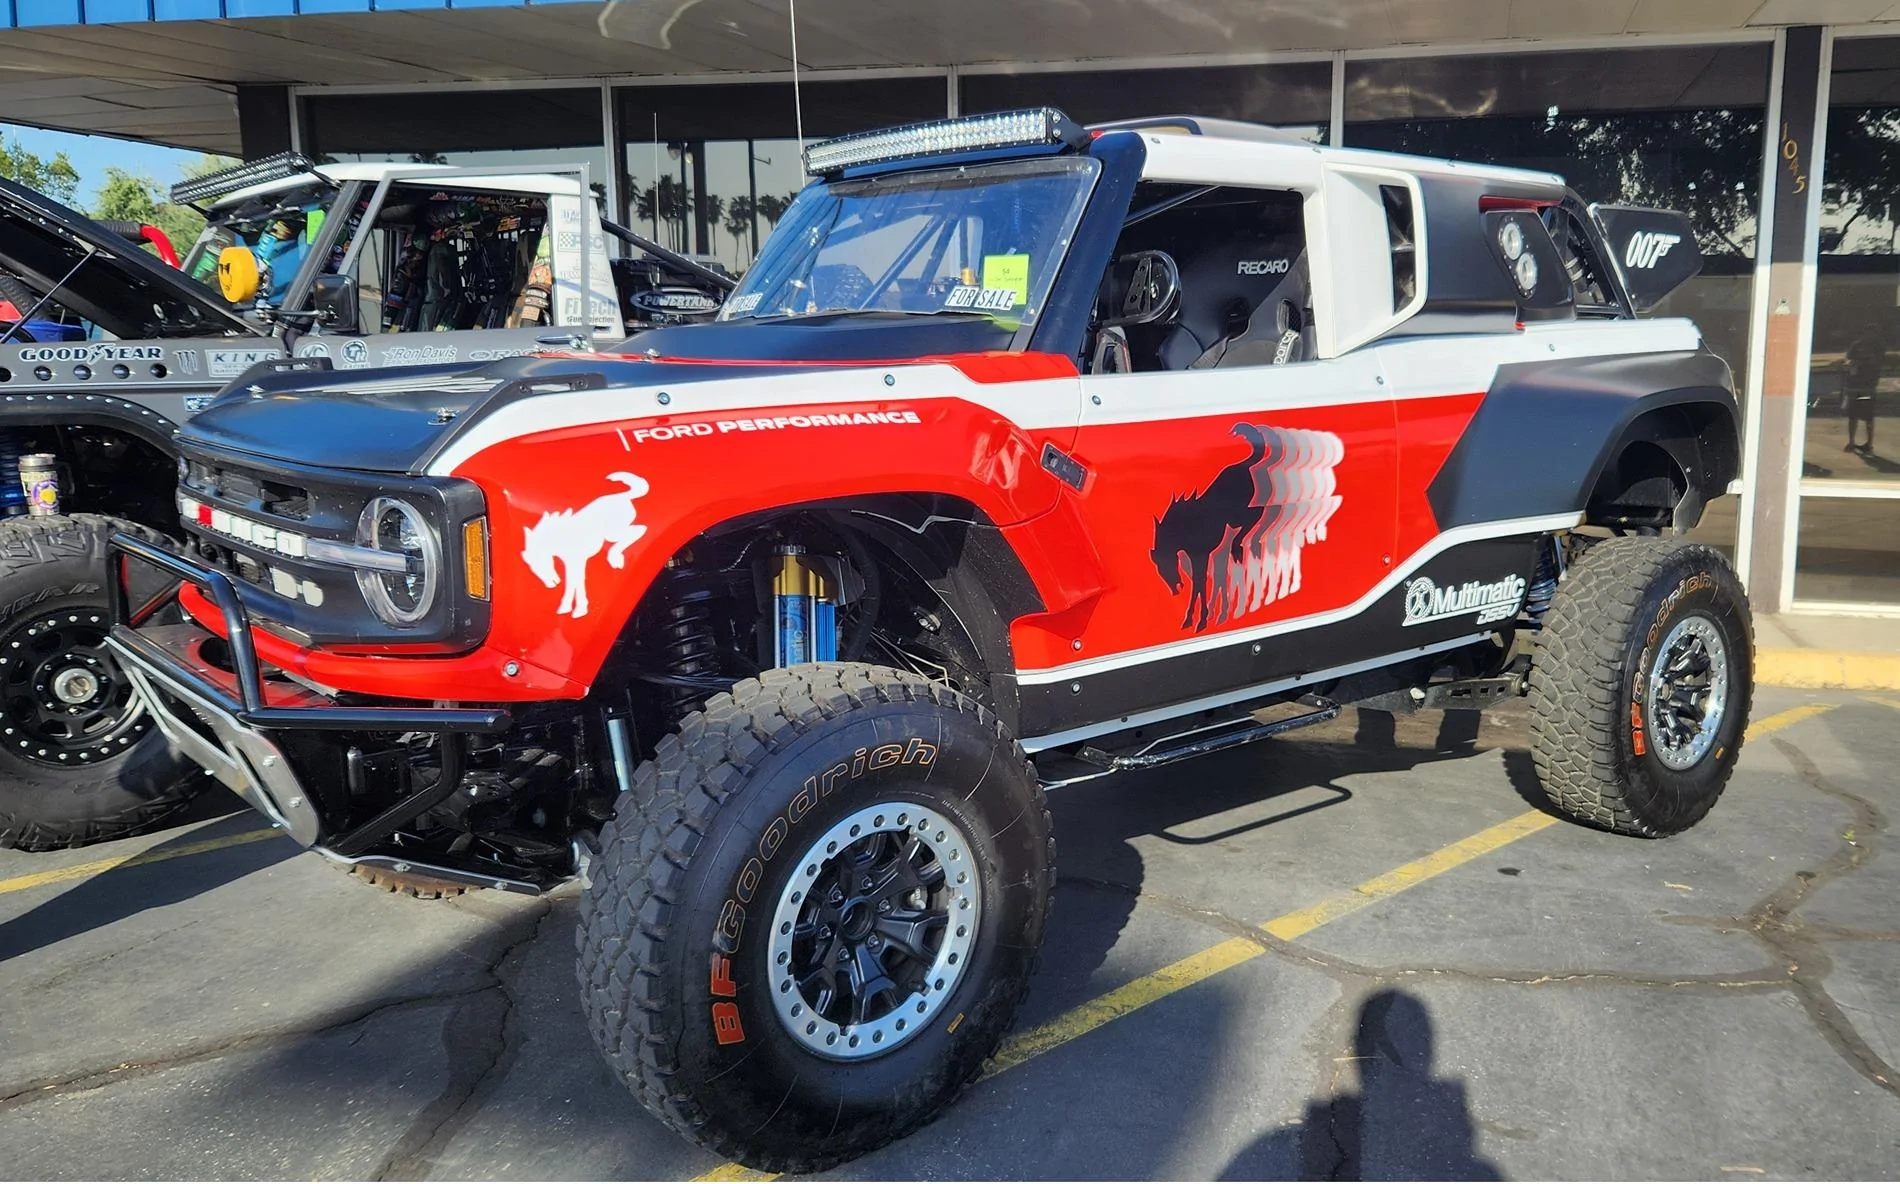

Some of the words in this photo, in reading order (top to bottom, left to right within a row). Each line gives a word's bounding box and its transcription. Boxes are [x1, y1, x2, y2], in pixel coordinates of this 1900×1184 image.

[1782, 122, 1806, 194] 1045
[1238, 260, 1288, 274] RECARO
[1626, 231, 1672, 269] 007
[947, 288, 977, 305] FOR
[977, 290, 1016, 308] SALE
[20, 346, 162, 363] GOODYEAR
[392, 348, 419, 360] Ron
[421, 346, 457, 358] Davis
[1273, 330, 1297, 366] parco
[632, 423, 713, 443] FORD
[717, 411, 921, 433] PERFORMANCE
[1432, 573, 1526, 615] Multimatic
[1631, 571, 1714, 756] BFGoodrich
[710, 738, 937, 1045] BFGoodrich
